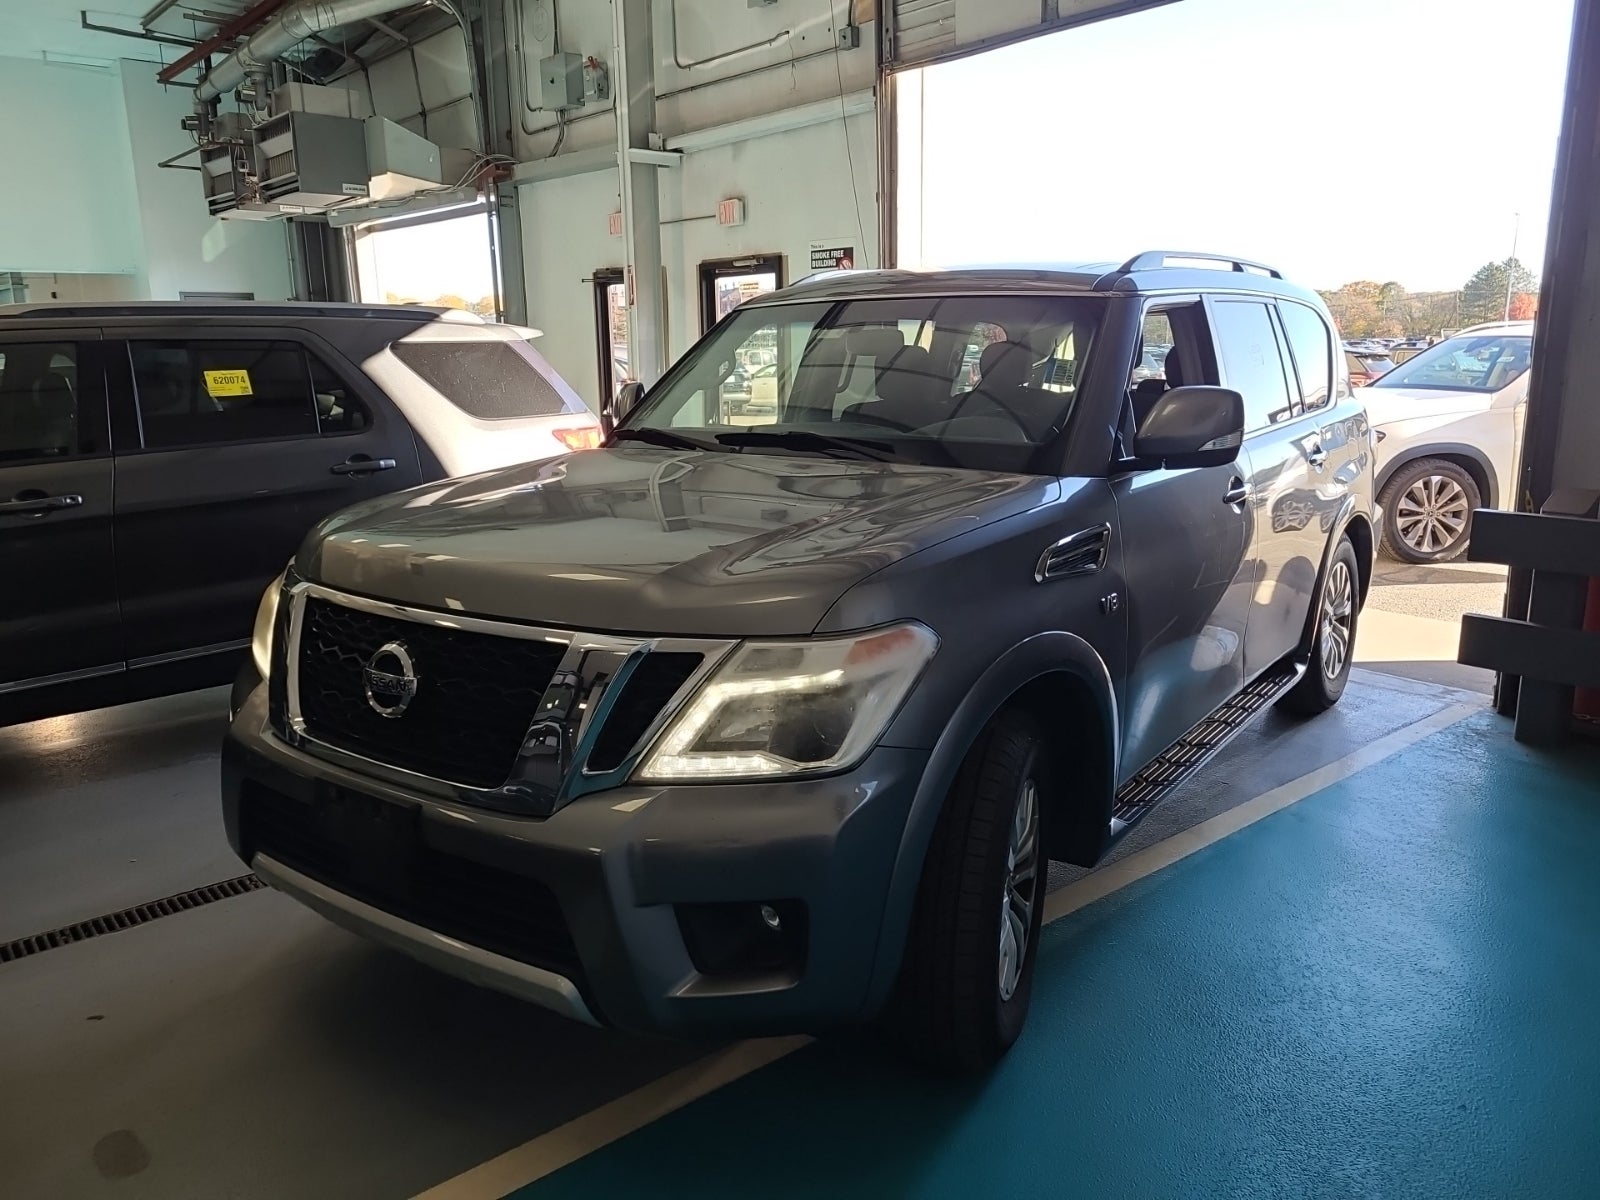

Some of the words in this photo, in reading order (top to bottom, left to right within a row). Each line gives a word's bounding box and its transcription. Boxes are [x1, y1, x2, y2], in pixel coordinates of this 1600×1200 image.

[719, 201, 736, 224] EXIT
[811, 251, 830, 260] SMOKE
[831, 250, 844, 258] FREE
[811, 259, 837, 268] BUILDING
[213, 376, 246, 384] 620074
